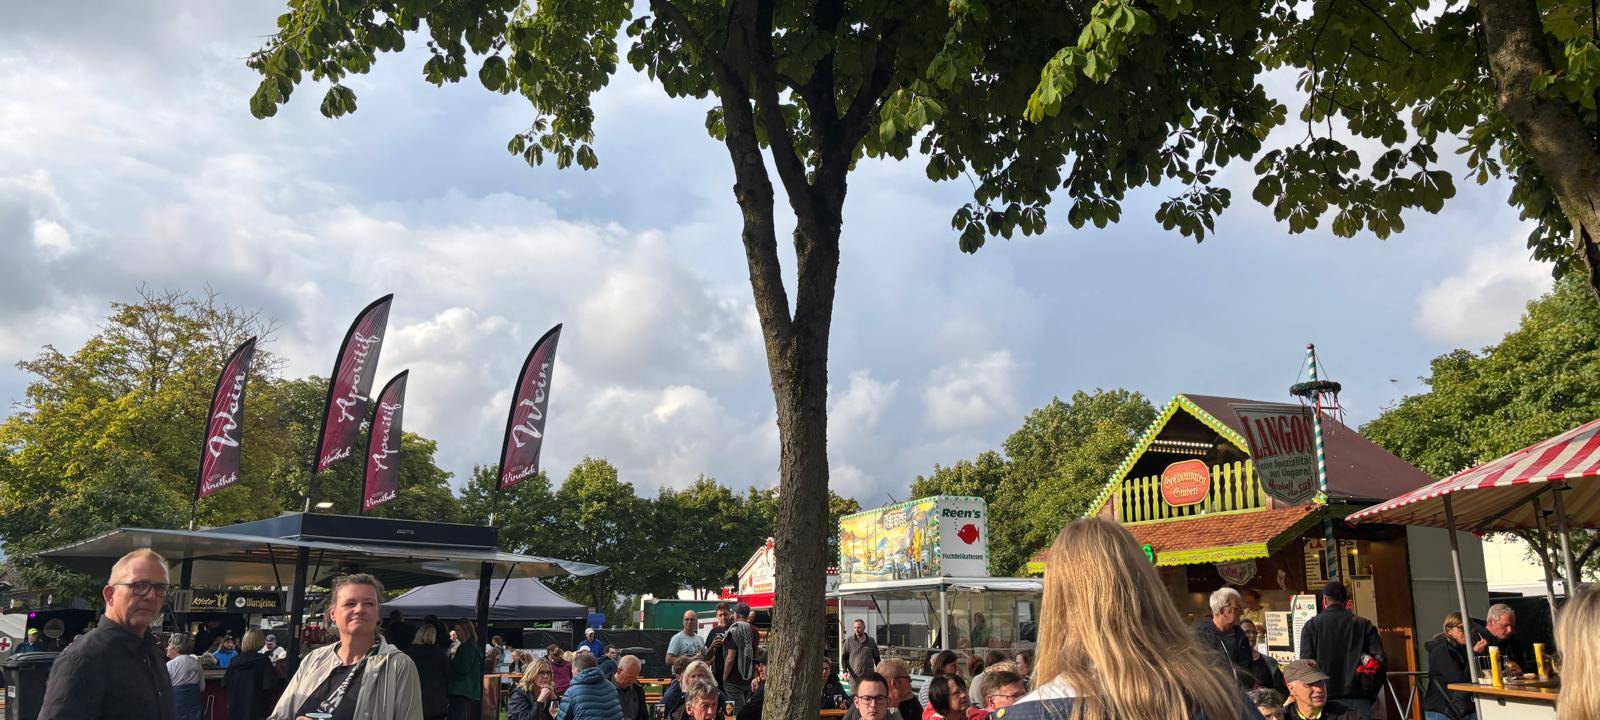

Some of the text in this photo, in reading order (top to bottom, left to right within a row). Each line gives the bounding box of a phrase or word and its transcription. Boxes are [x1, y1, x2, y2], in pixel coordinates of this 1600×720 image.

[336, 331, 381, 423] Aperitif
[209, 371, 246, 458] Wein
[513, 363, 549, 448] Wein
[372, 402, 402, 471] Aperitif
[202, 471, 237, 493] Vinothek
[502, 463, 536, 485] Vinothek
[366, 488, 396, 508] Vinothek
[942, 508, 981, 518] Reen's
[942, 552, 984, 561] Fischdelikatessen
